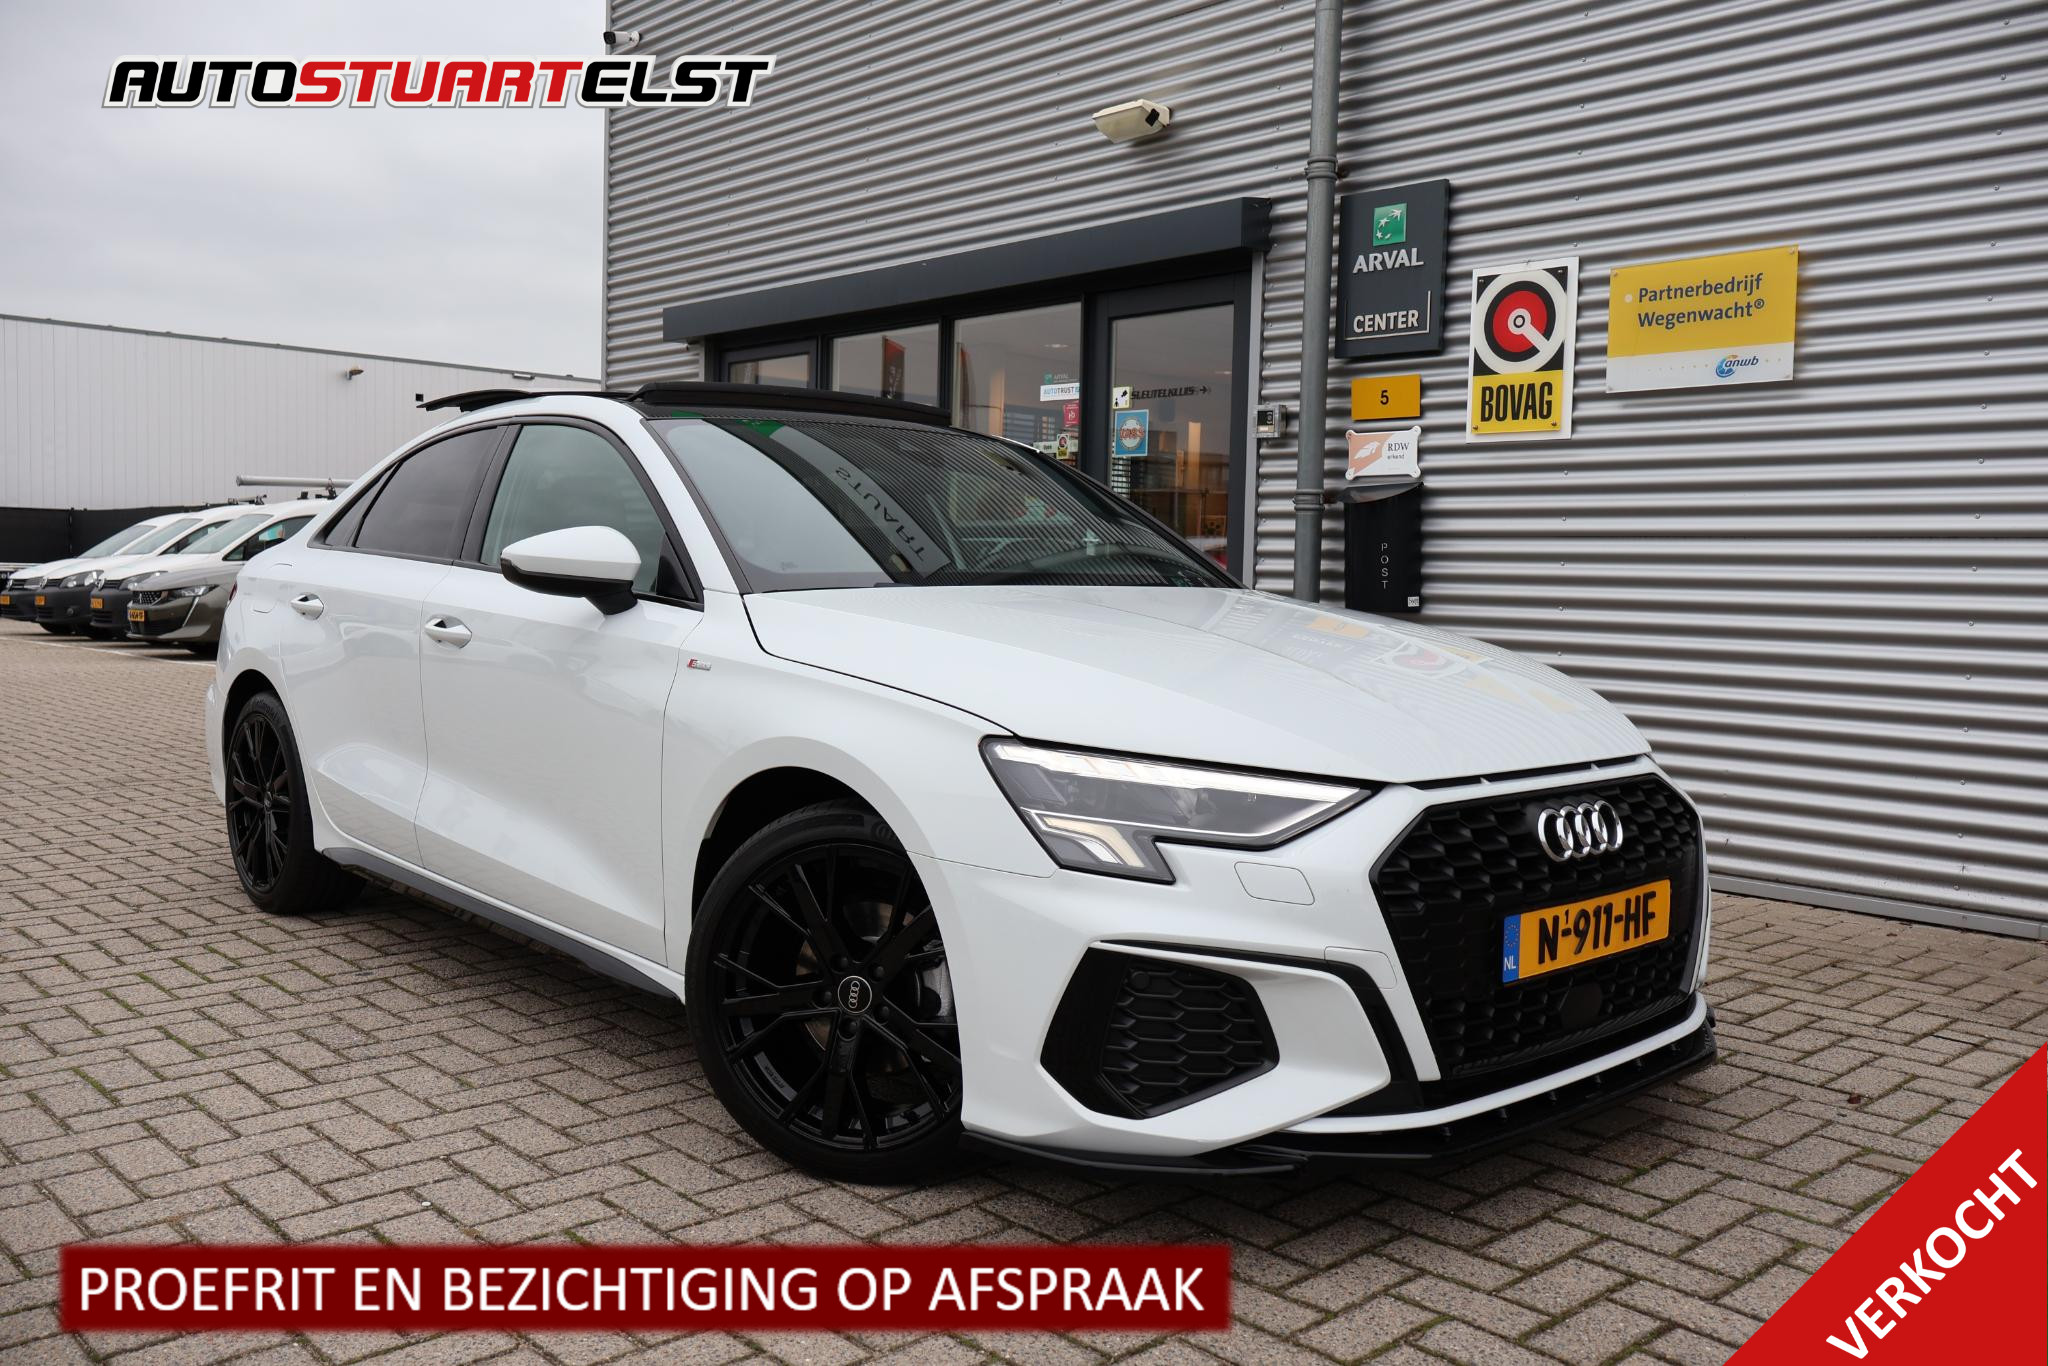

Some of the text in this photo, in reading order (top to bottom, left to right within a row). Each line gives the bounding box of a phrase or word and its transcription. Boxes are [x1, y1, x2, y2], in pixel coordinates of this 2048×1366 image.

[1352, 247, 1424, 274] ARVAL
[1638, 273, 1763, 303] Partnerbedrijf
[1353, 309, 1419, 333] CENTER
[1724, 355, 1759, 368] anwb
[1380, 389, 1389, 405] 5
[1480, 381, 1553, 422] BOVAG
[1387, 442, 1410, 452] RDW
[1380, 542, 1389, 590] POST
[1503, 955, 1517, 971] NL
